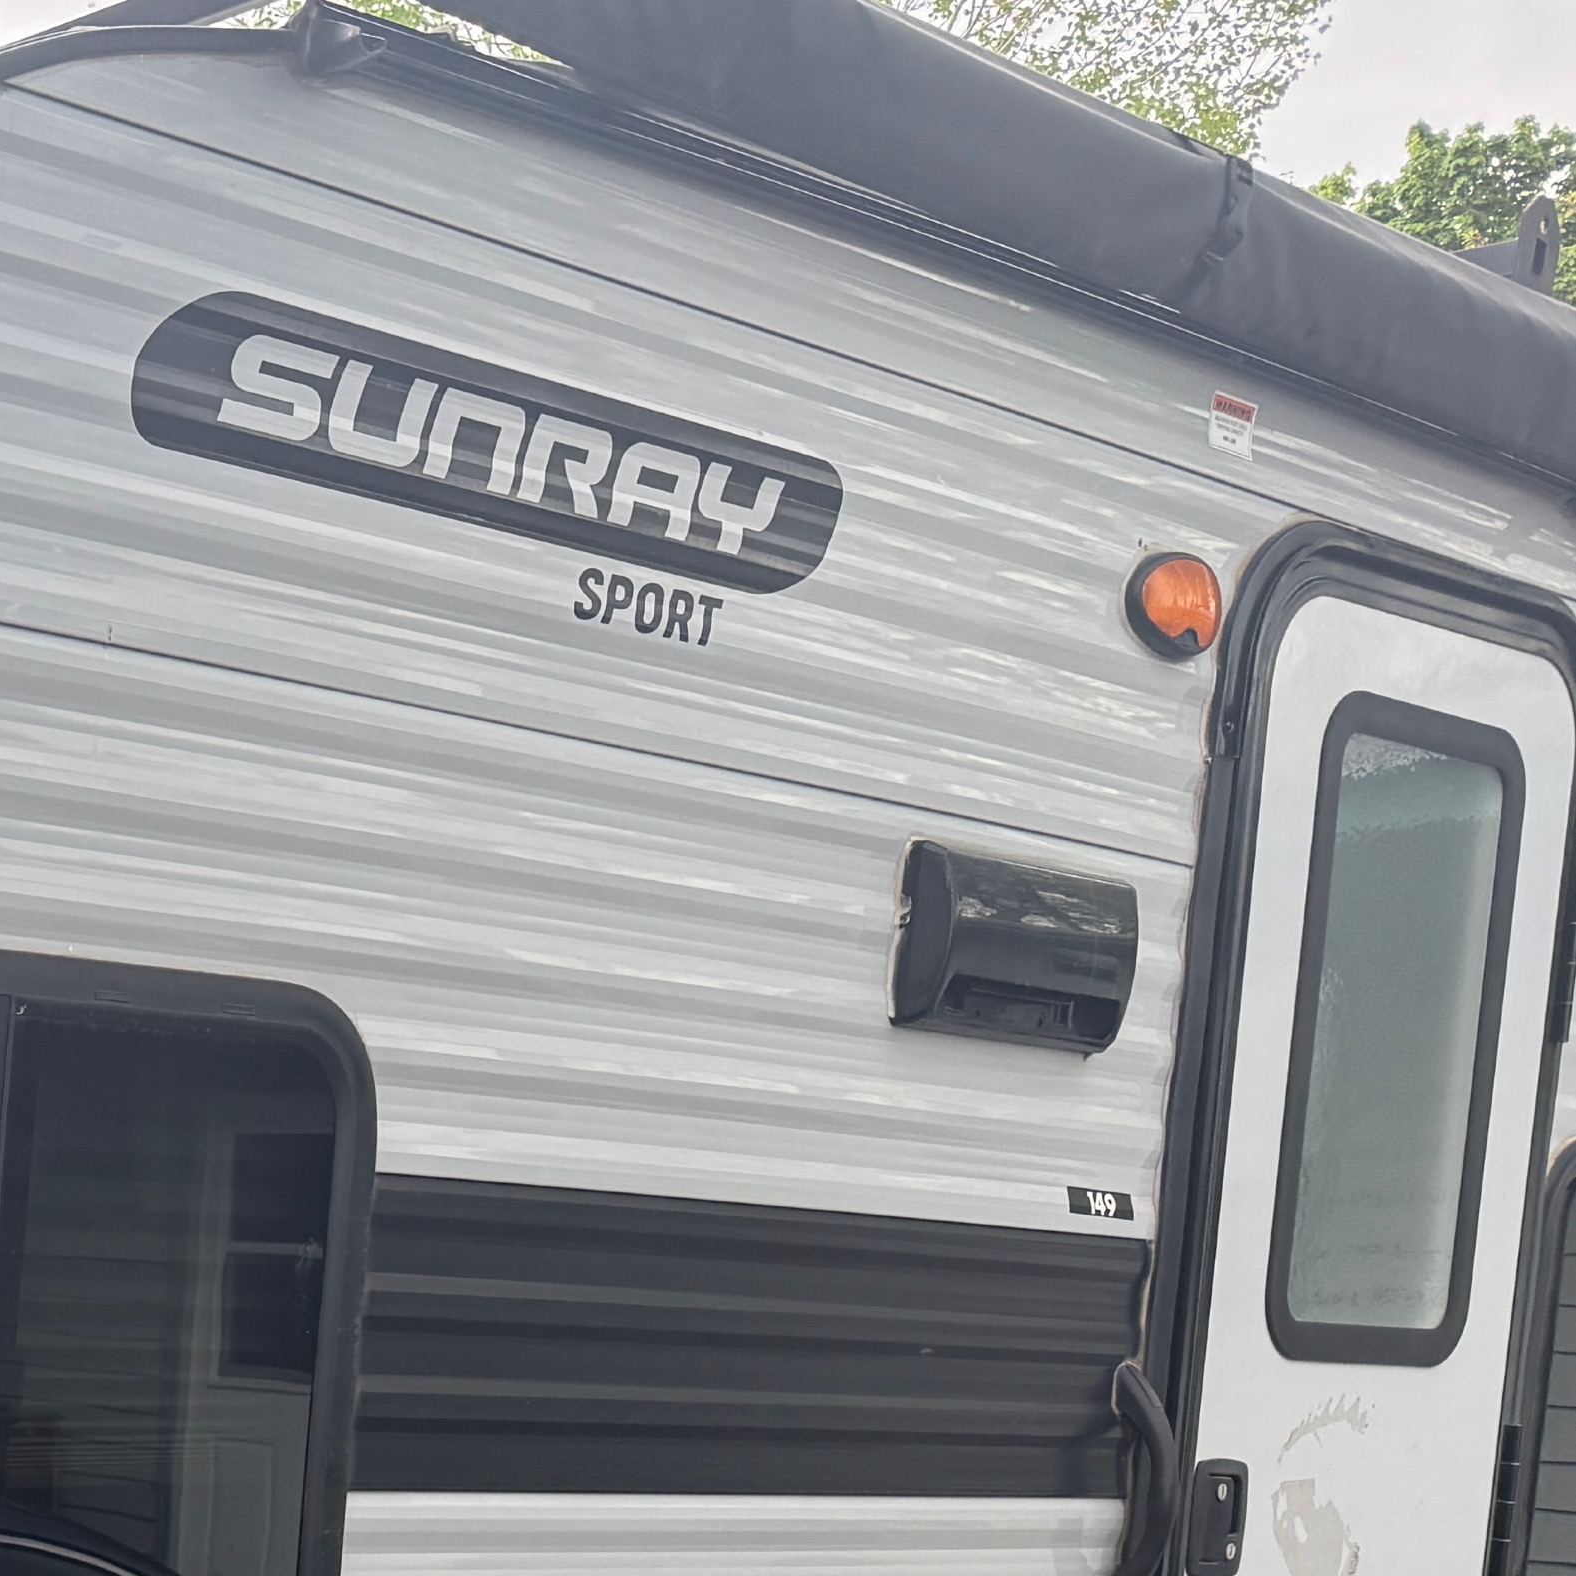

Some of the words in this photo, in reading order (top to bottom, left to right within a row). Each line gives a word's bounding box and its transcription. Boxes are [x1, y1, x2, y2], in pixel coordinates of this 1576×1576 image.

[217, 334, 785, 555] SUNRAY
[573, 567, 723, 646] SPORT
[1087, 1191, 1116, 1217] 149
